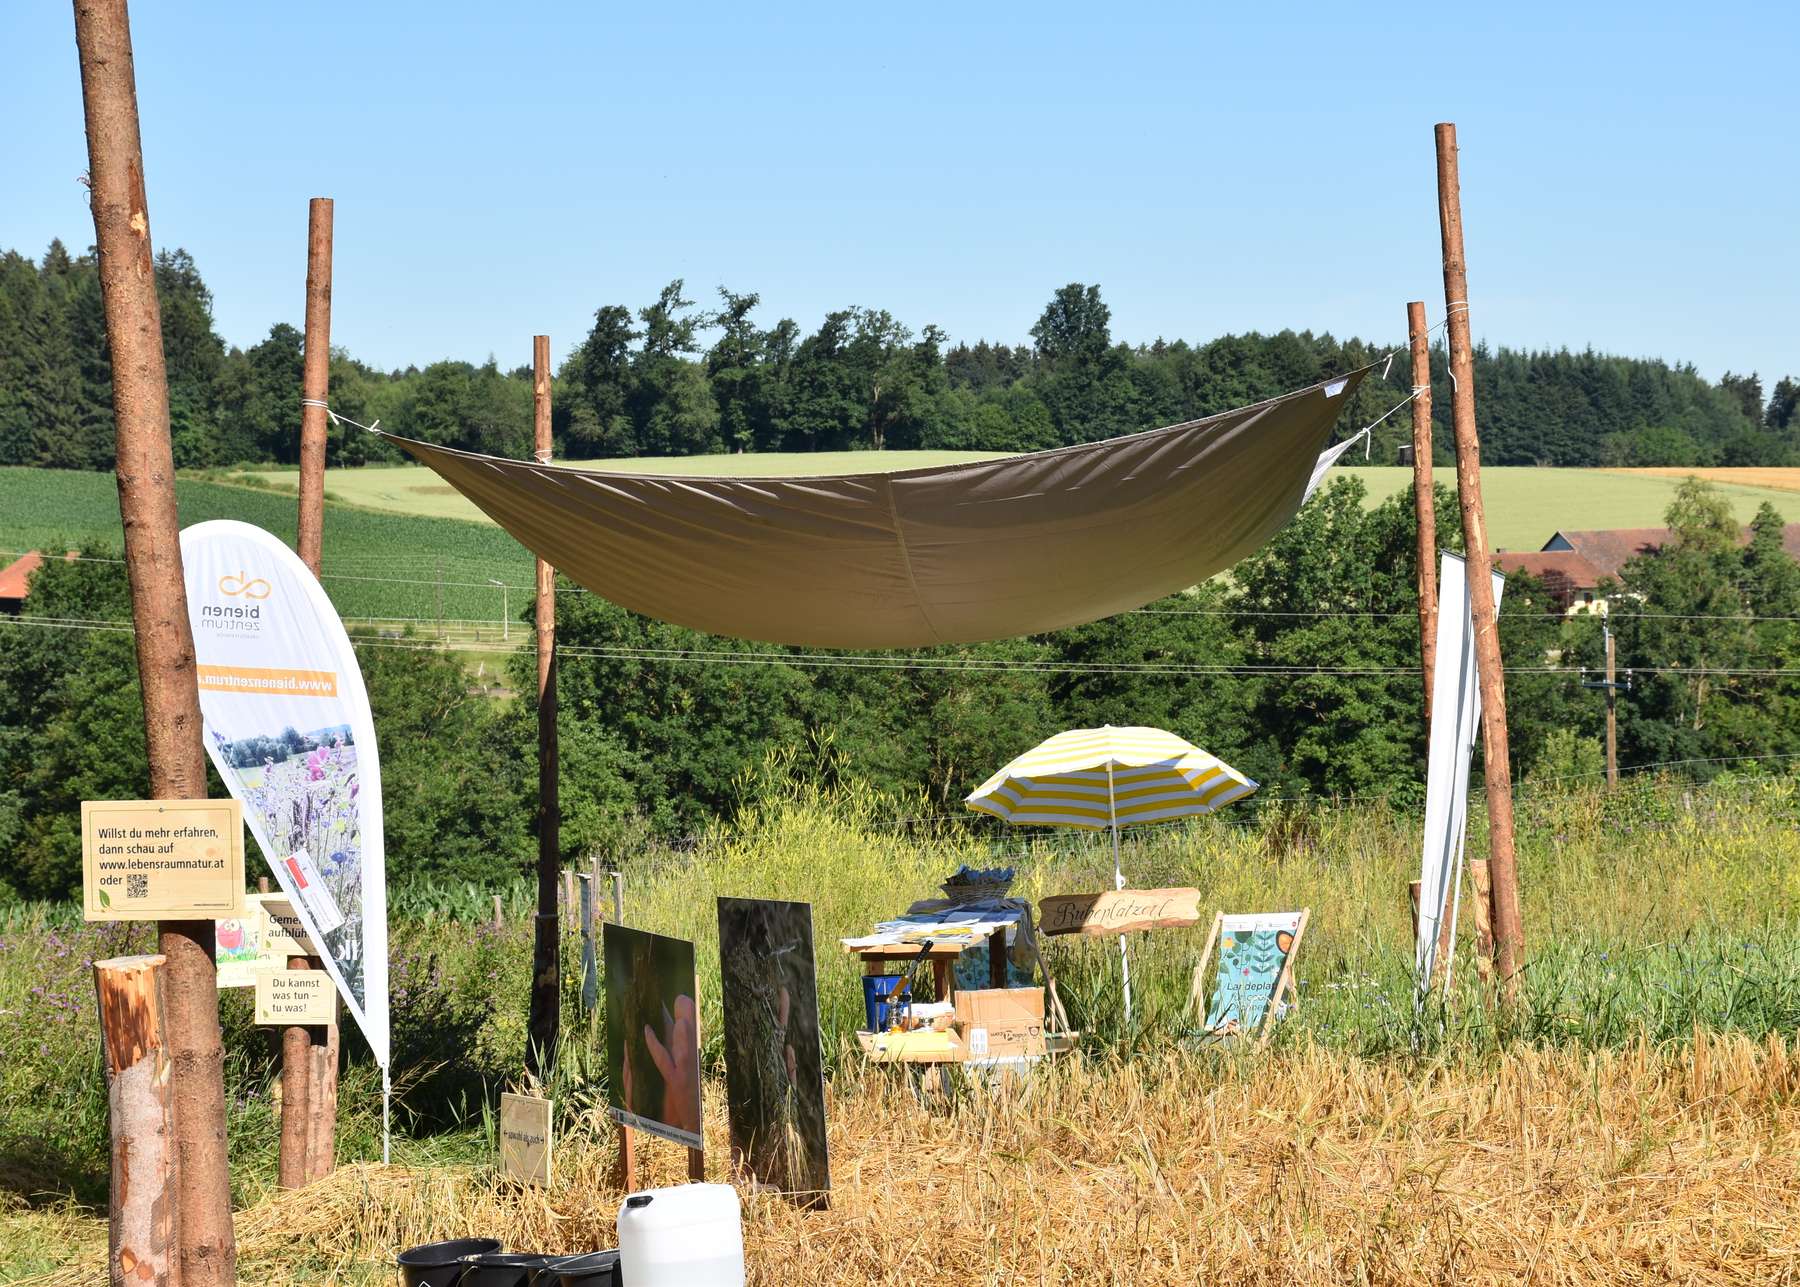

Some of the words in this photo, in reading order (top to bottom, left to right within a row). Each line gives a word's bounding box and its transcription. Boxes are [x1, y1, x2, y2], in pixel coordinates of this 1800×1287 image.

[98, 828, 127, 839] Willst
[129, 828, 142, 838] du
[145, 827, 171, 838] mehr
[173, 826, 219, 839] erfahren,
[99, 844, 124, 854] dann
[126, 843, 155, 854] schau
[157, 842, 174, 853] auf
[99, 859, 225, 870] www.lebensraumnatur.at
[100, 875, 122, 885] oder
[268, 927, 309, 938] aufblüh
[272, 978, 286, 988] Du
[288, 978, 320, 988] kannst
[294, 991, 309, 1000] tun
[272, 1003, 283, 1012] tu
[285, 1003, 307, 1012] was!
